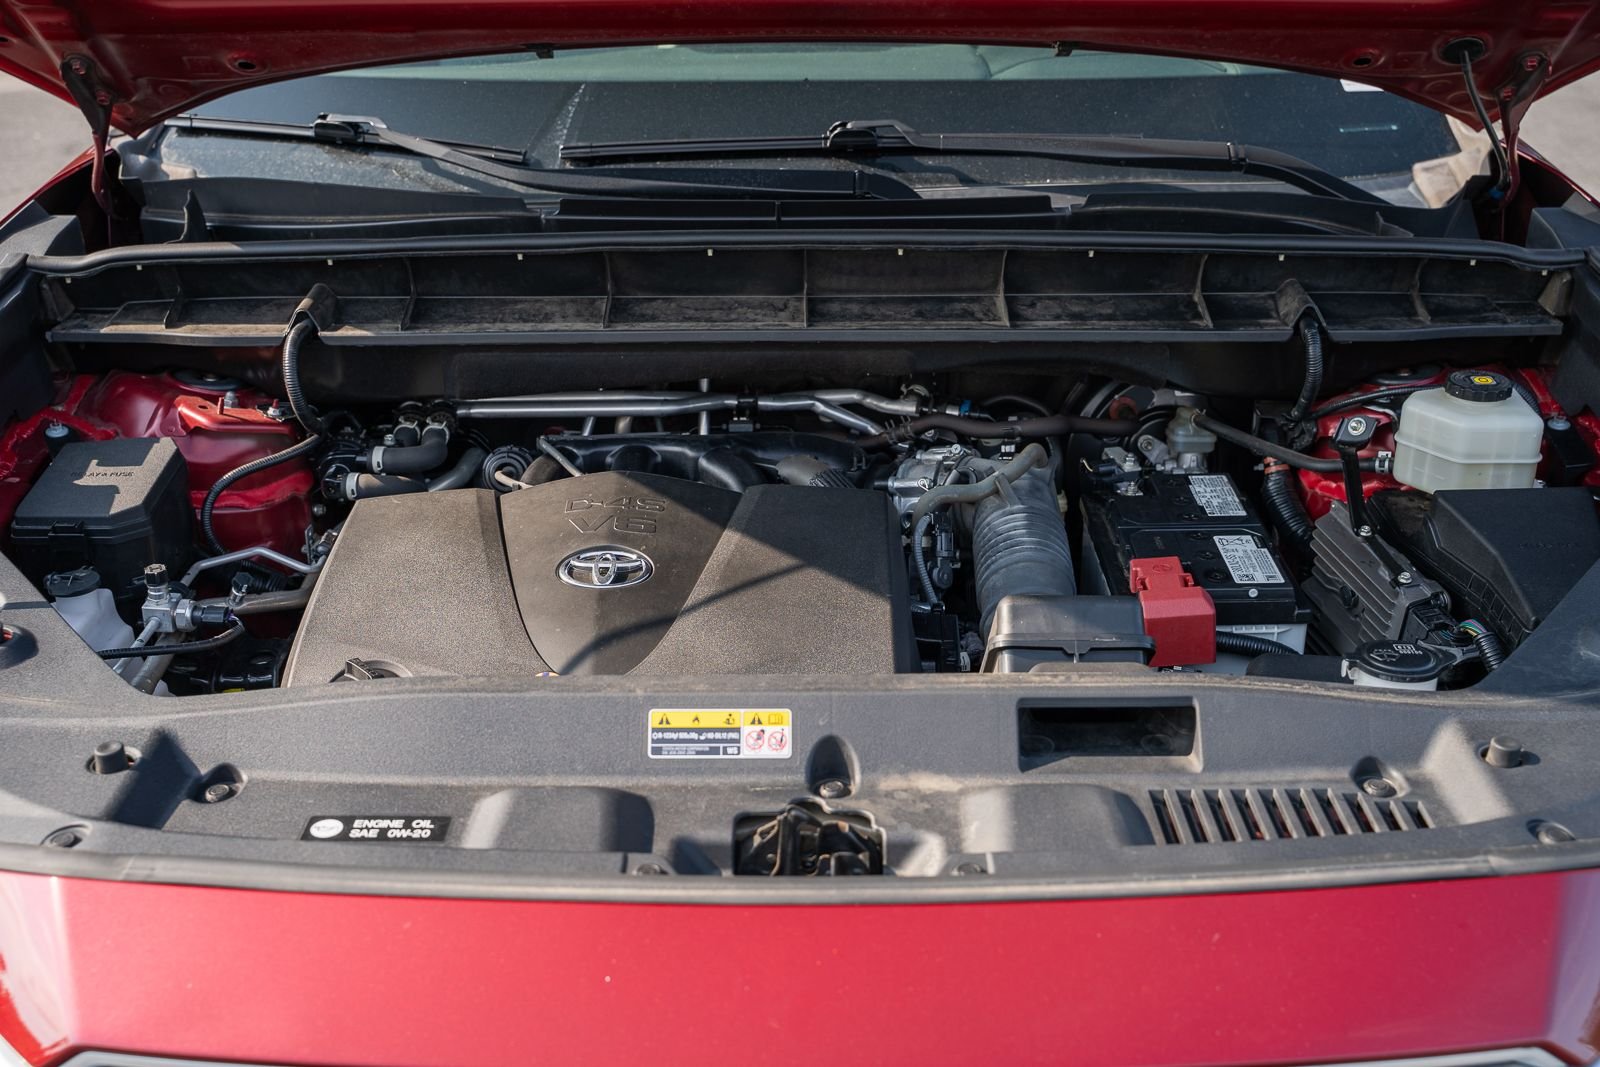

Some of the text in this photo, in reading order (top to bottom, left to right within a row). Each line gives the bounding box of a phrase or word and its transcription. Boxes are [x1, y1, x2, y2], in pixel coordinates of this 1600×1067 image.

[564, 496, 666, 513] D-4S
[568, 515, 657, 534] V6
[352, 819, 434, 828] ENGINE OIL
[348, 829, 431, 838] SAE 0W-20
